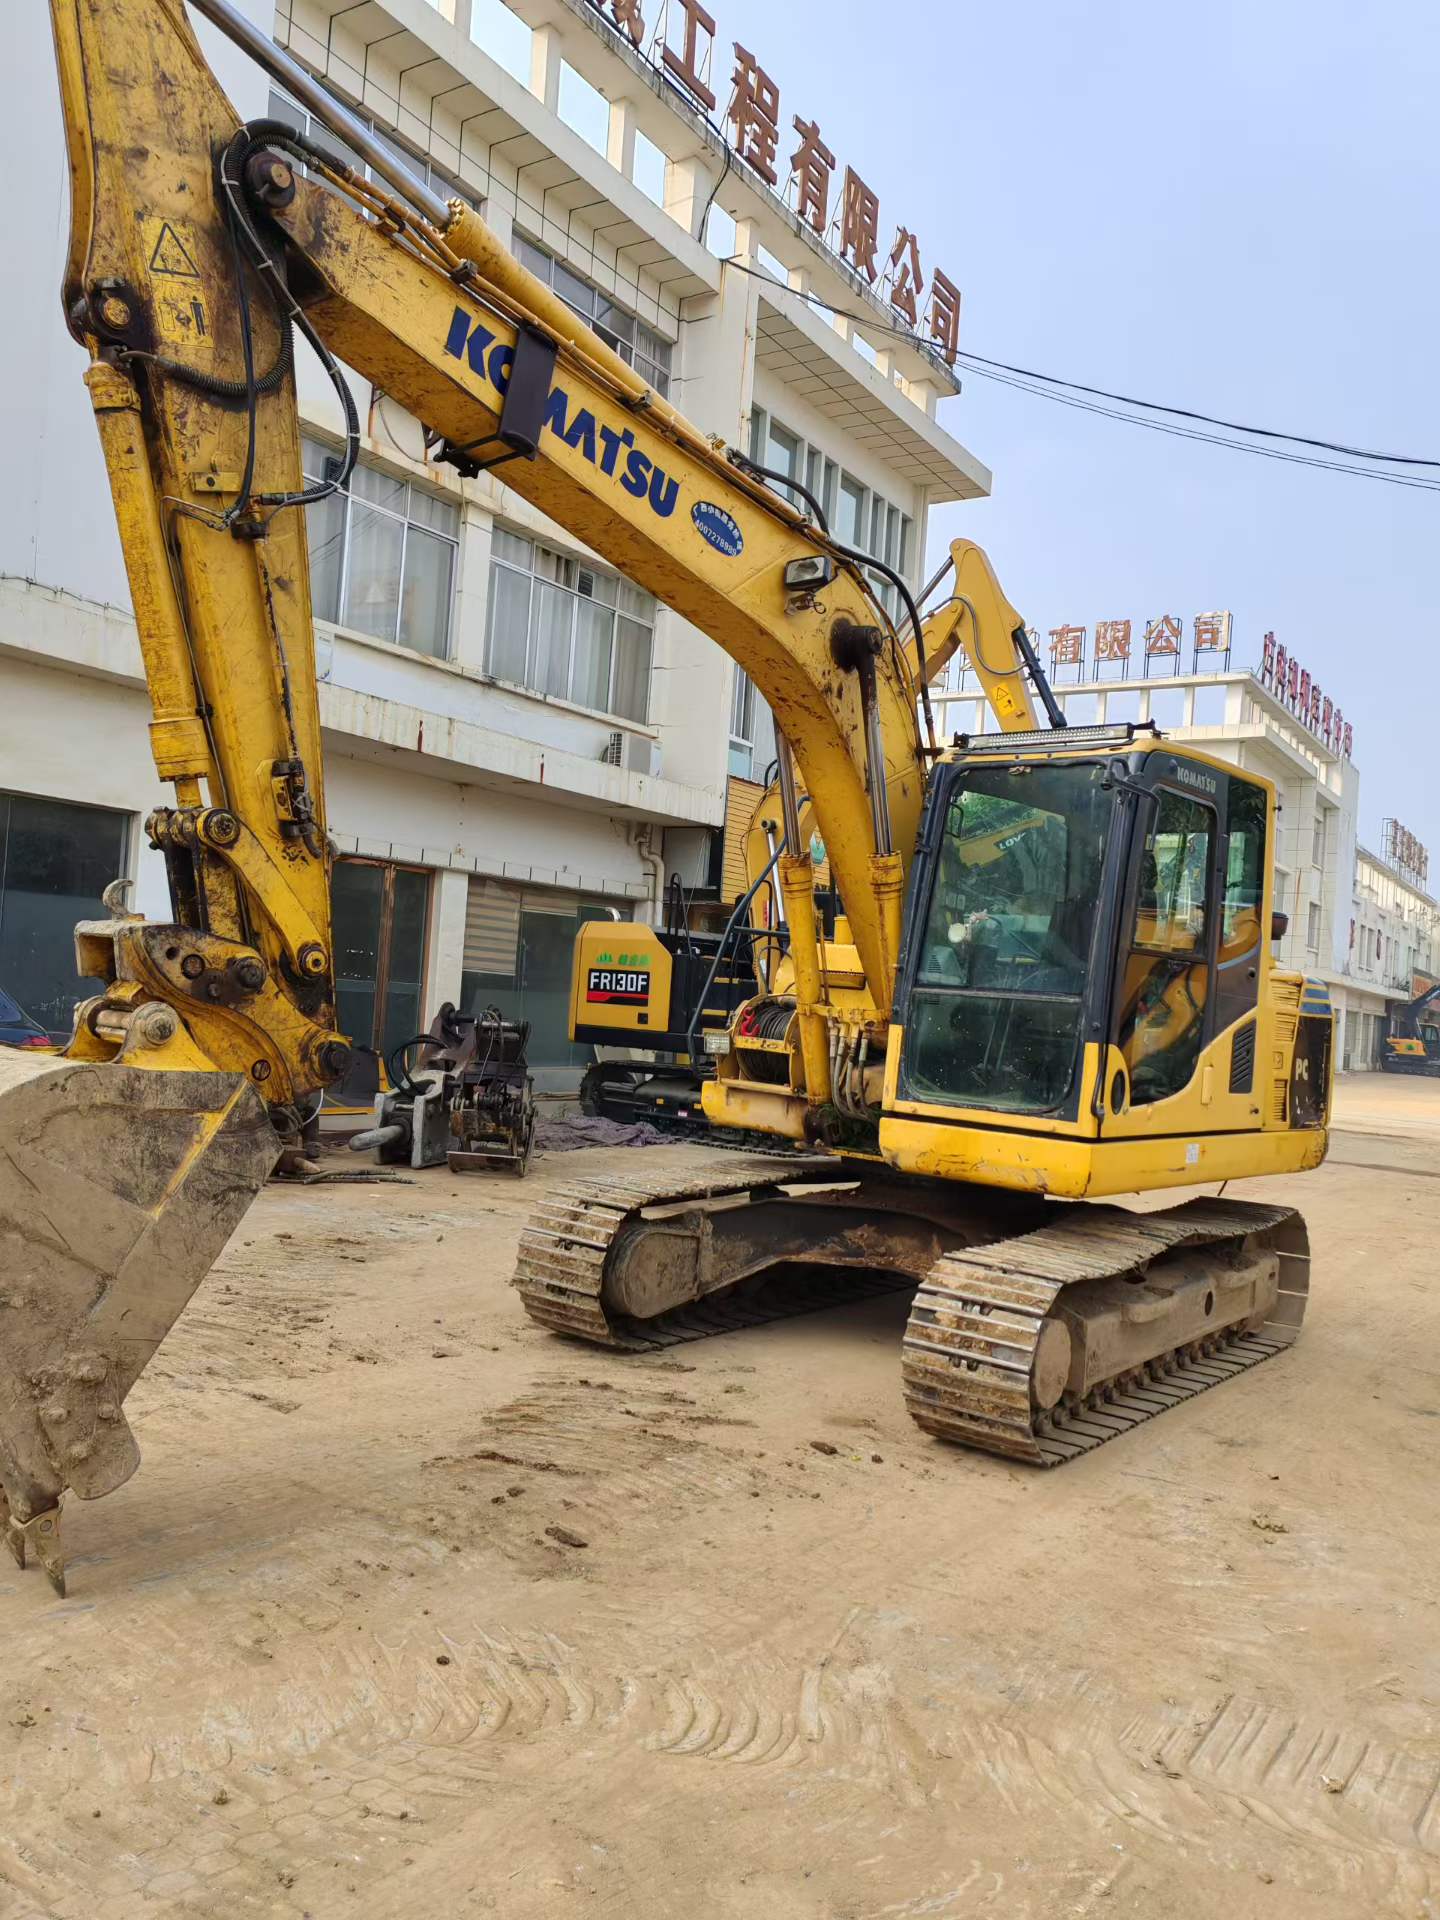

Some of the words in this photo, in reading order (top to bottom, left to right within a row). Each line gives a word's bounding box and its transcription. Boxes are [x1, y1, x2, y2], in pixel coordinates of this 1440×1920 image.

[1177, 766, 1216, 794] KOMATSU
[590, 971, 648, 992] FR130F
[1296, 1058, 1309, 1080] PC
